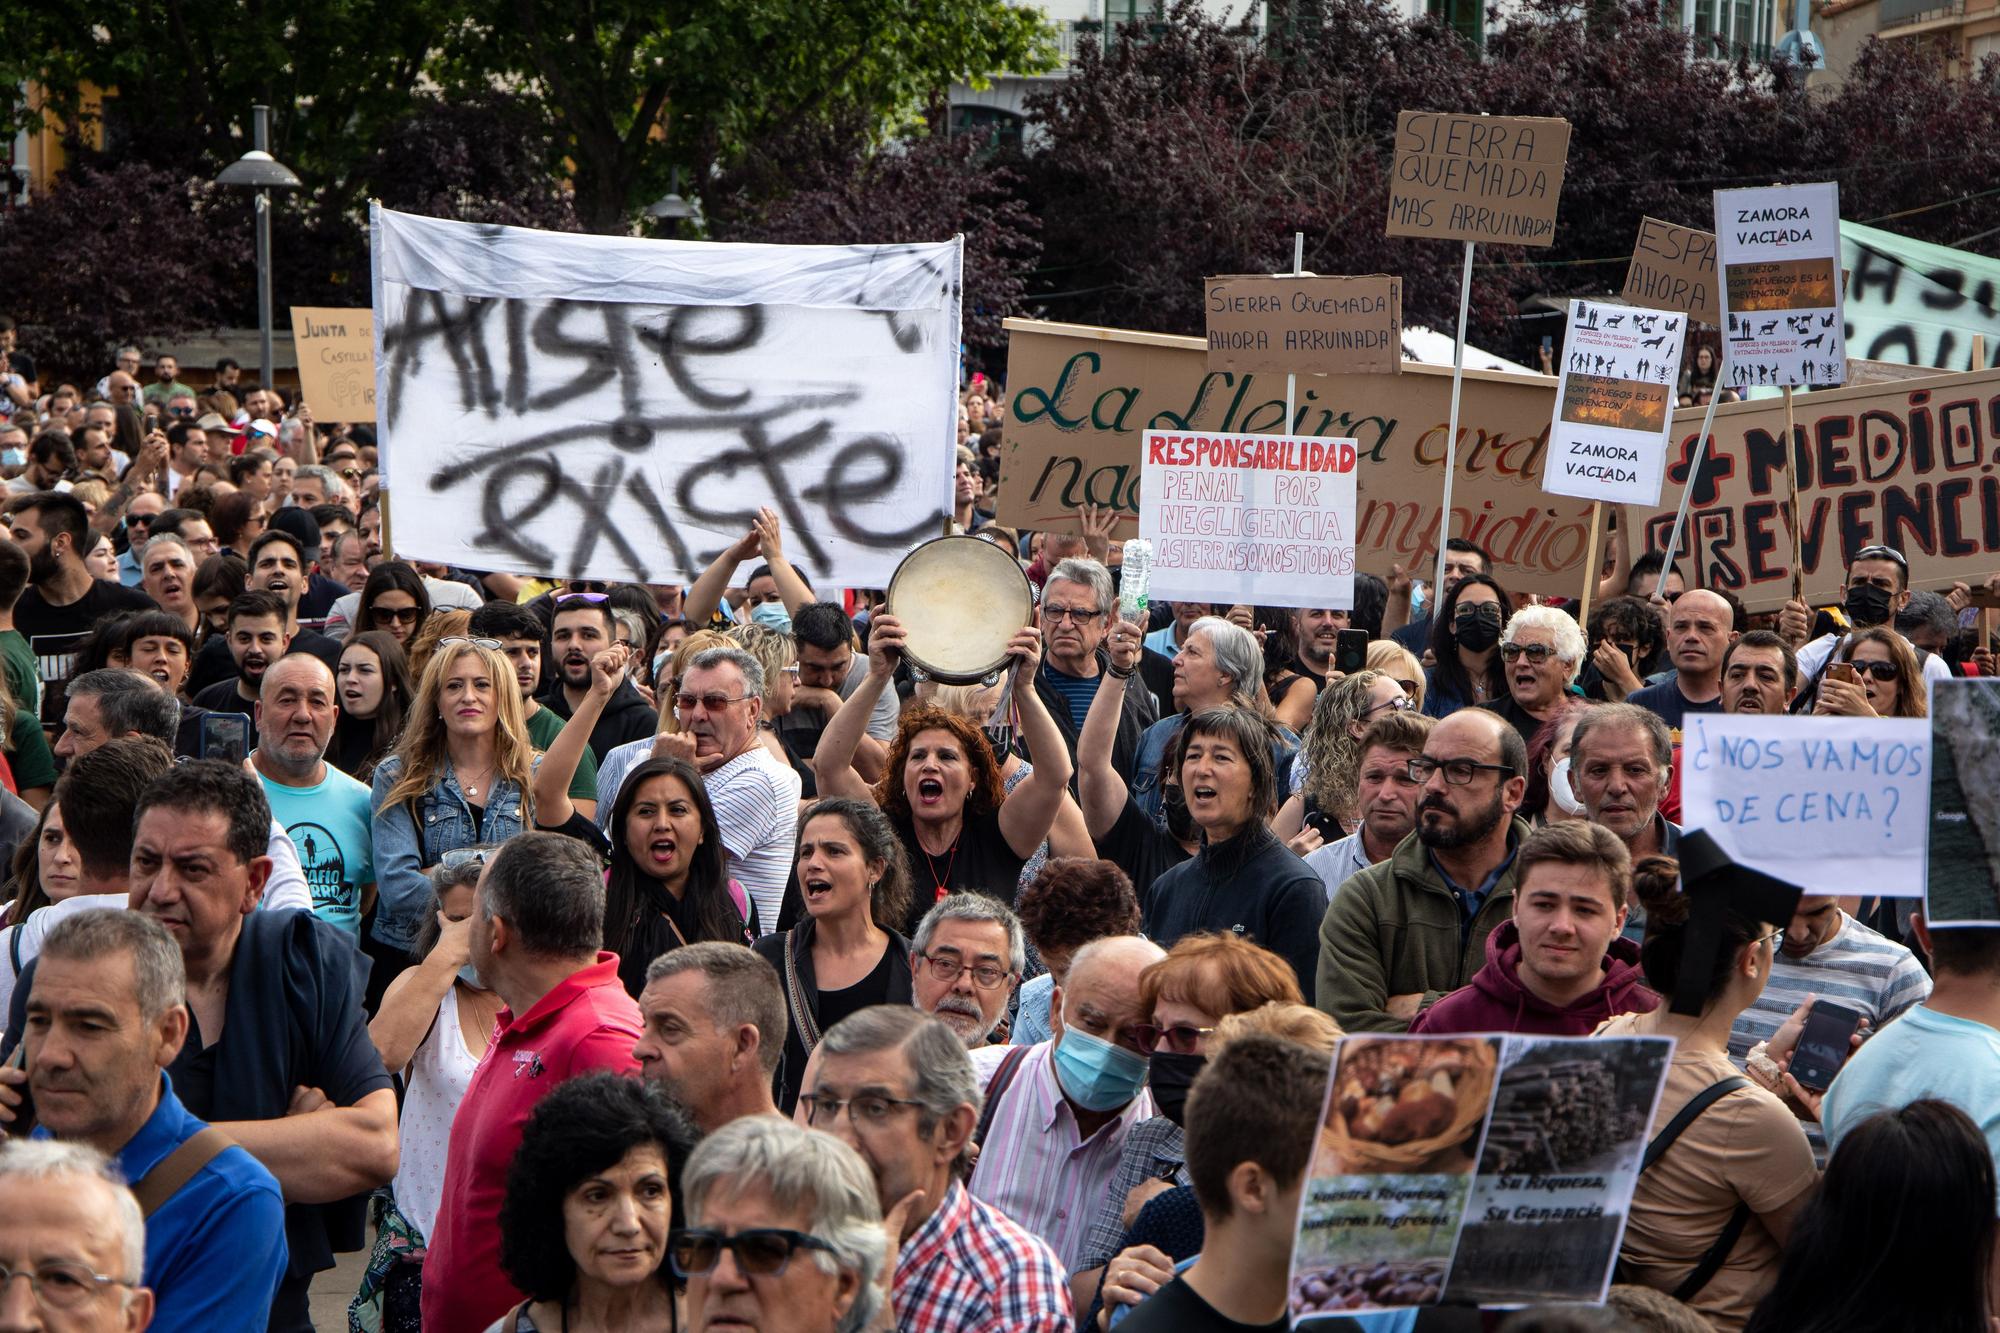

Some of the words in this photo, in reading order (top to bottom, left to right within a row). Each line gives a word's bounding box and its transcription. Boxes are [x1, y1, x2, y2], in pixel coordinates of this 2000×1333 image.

[1406, 115, 1535, 161] SIERRA
[1400, 155, 1546, 198] QUEMADA
[1391, 195, 1435, 227] MAS
[1737, 207, 1810, 223] ZAMORA
[1728, 274, 1797, 288] CORTAFUEGOS
[1800, 273, 1813, 282] ES
[1815, 273, 1828, 281] LA
[1747, 265, 1781, 274] MEJOR
[1629, 262, 1706, 311] AHORA
[1291, 291, 1386, 314] QUEMADA
[301, 317, 346, 339] JUNTA
[359, 327, 371, 337] DE
[1209, 330, 1268, 350] AHORA
[321, 347, 368, 365] CASTILLA
[1587, 375, 1619, 385] MEJOR
[1012, 351, 1140, 434] La
[1566, 384, 1633, 399] CORTAFUEGOS
[1635, 391, 1648, 401] ES
[1650, 394, 1662, 402] LA
[1150, 436, 1356, 474] RESPONSABILIDAD
[1570, 441, 1638, 461] ZAMORA
[1163, 470, 1244, 503] PENAL
[1275, 475, 1321, 506] POR
[1159, 505, 1342, 541] NEGLIGENCIA
[1693, 718, 1784, 771] ¿NOS
[1802, 739, 1923, 777] VAMOS
[1715, 796, 1760, 824] DE
[1776, 786, 1900, 838] CENA?
[1936, 811, 1967, 822] Google
[1495, 1176, 1523, 1190] Su
[1526, 1175, 1607, 1193] Riqueza,
[1483, 1206, 1508, 1221] Su
